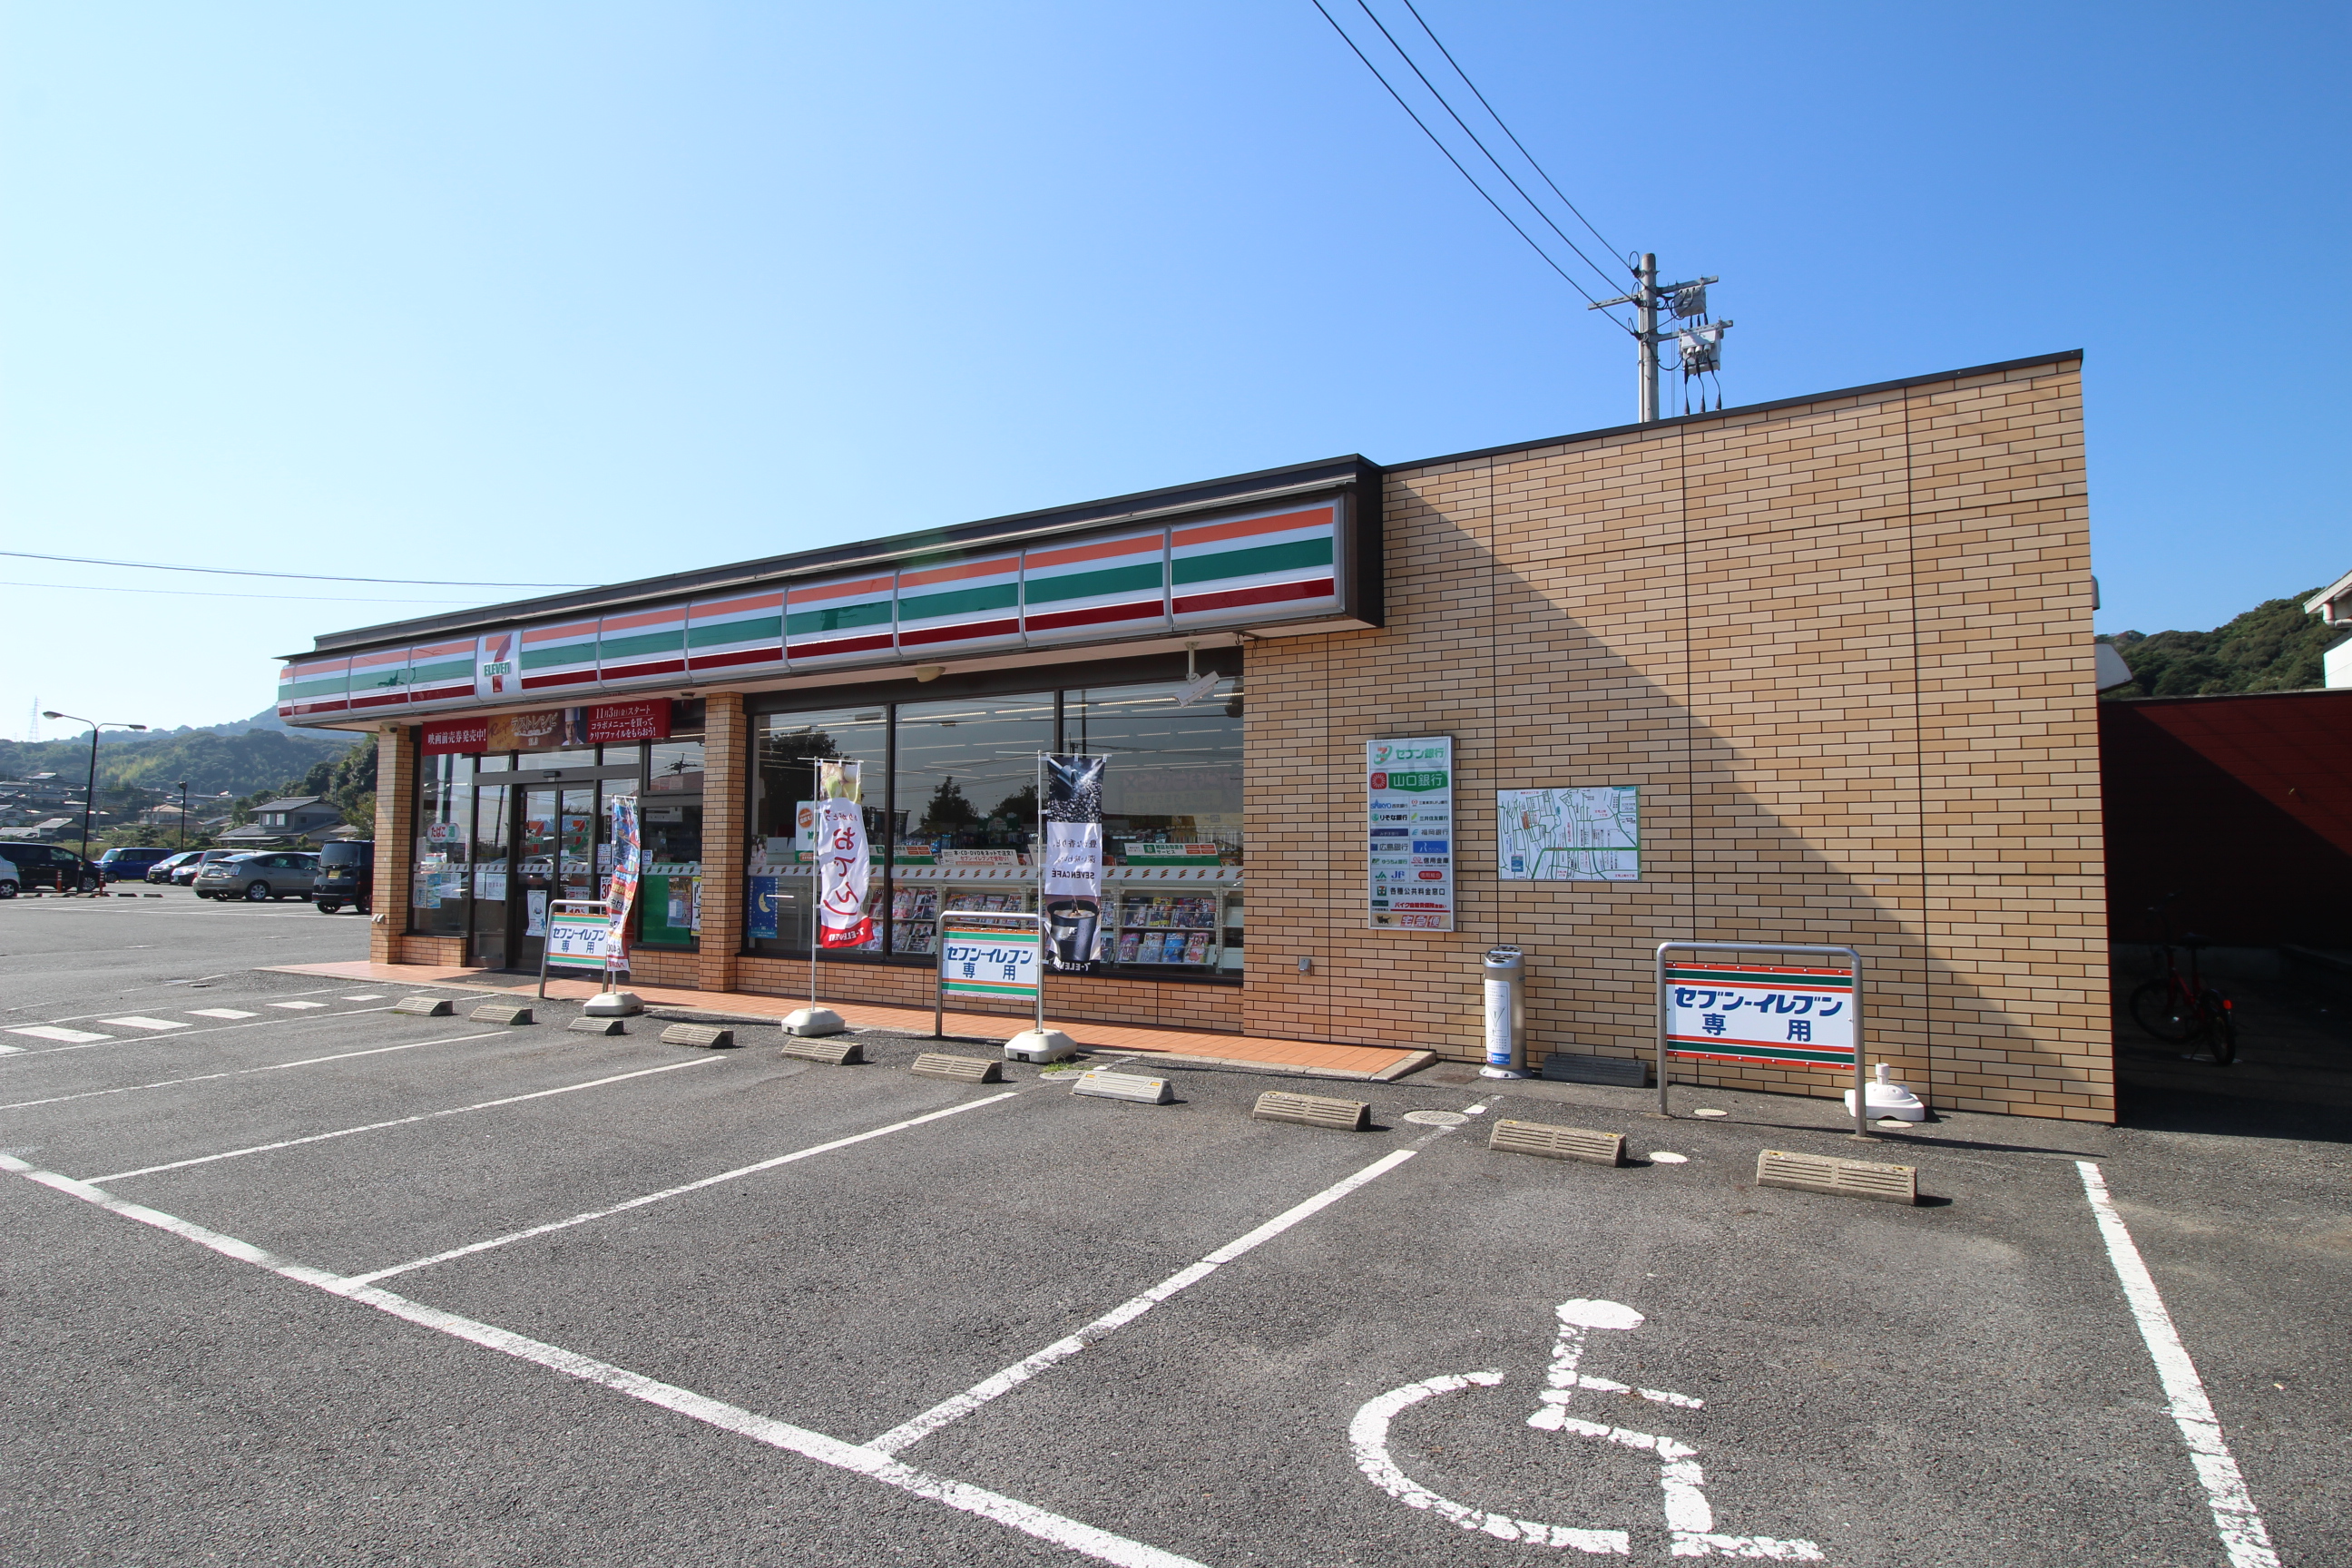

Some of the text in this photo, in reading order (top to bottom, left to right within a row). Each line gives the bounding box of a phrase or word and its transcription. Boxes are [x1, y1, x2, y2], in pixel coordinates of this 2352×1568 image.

[511, 711, 558, 731] ラストレシピ
[591, 717, 654, 730] コラボメニューを買って
[427, 729, 486, 745] 映画前売券発売中!
[589, 727, 656, 740] クリアファイルをもらおう!
[1396, 748, 1445, 760] セブン銀行
[1393, 773, 1443, 787] 山口銀行
[431, 826, 446, 838] たばこ
[1379, 843, 1408, 851] 広島銀行
[1390, 887, 1446, 896] 各種公共料金窓口
[1402, 916, 1440, 926] 宅急便
